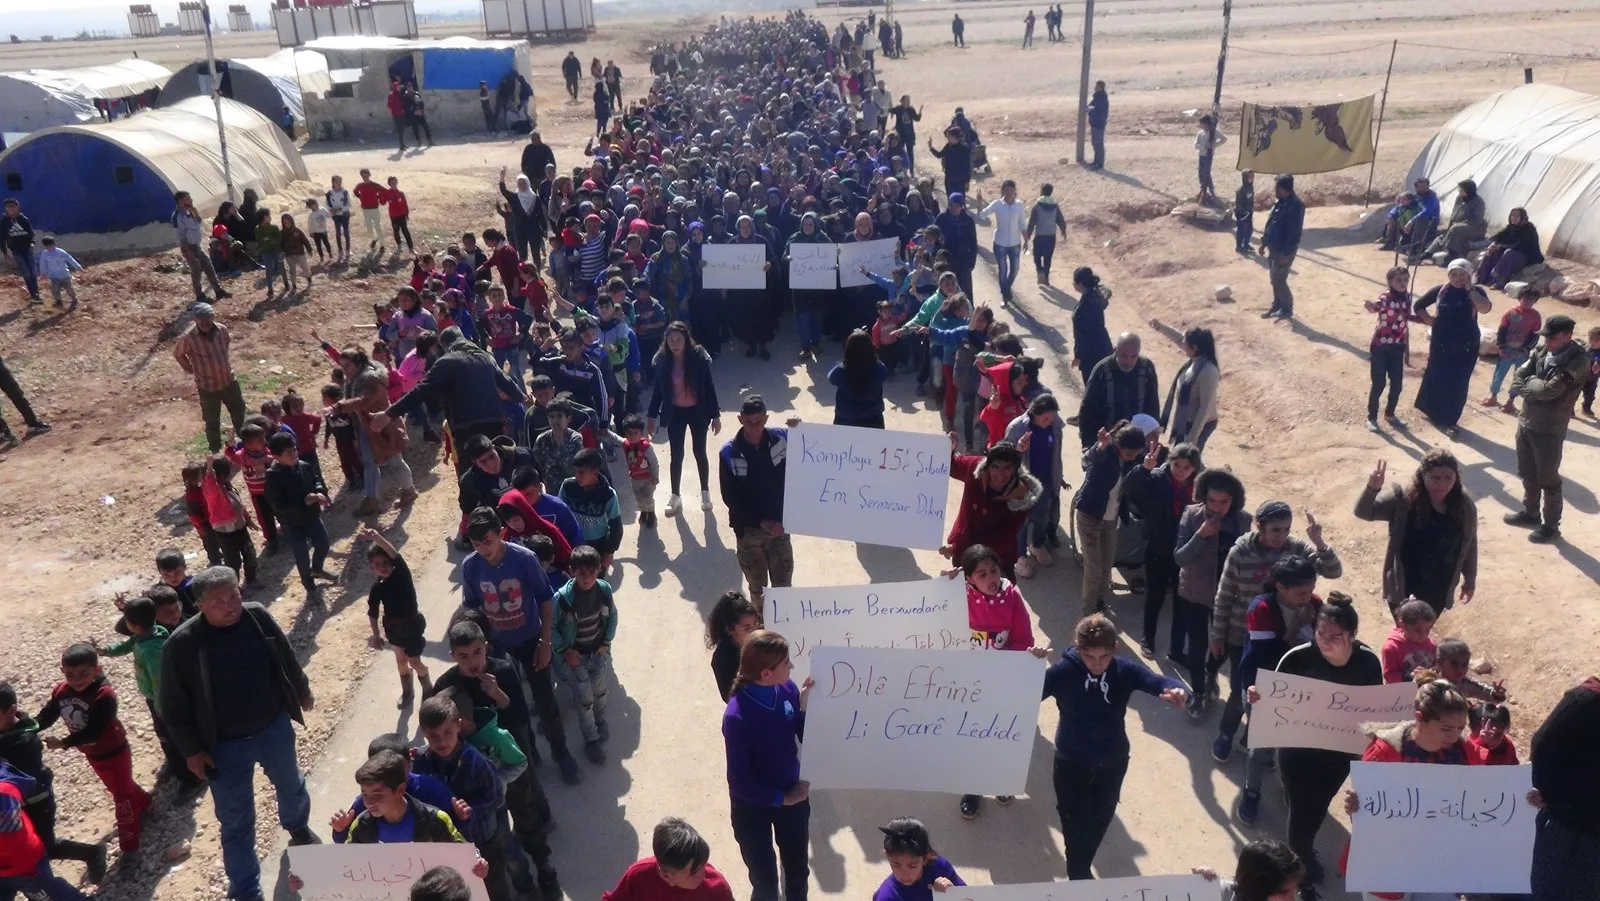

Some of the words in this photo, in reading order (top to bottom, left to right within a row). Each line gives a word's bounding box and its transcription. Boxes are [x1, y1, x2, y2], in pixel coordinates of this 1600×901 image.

[487, 312, 513, 320] FILA
[819, 478, 847, 504] Em
[773, 600, 789, 624] Li
[800, 600, 854, 619] Hember
[828, 661, 887, 698] Dilê
[846, 710, 868, 741] Li
[884, 707, 945, 740] Garê
[956, 710, 1021, 742] Lêdide
[1440, 790, 1516, 827] الخيانة
